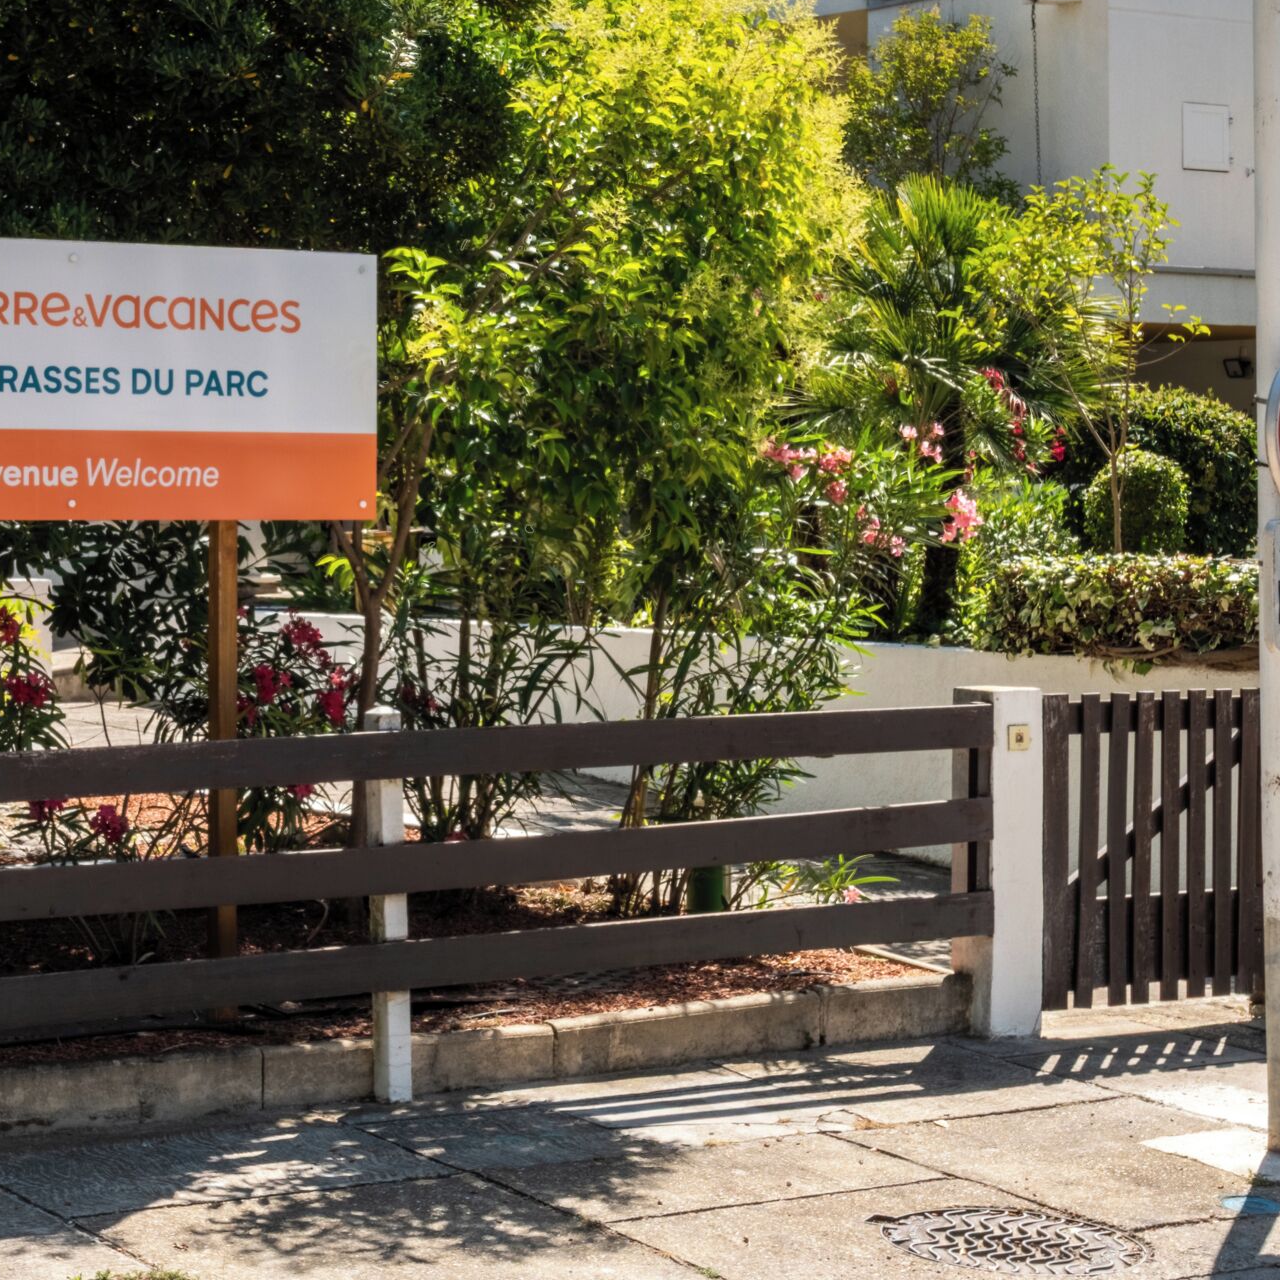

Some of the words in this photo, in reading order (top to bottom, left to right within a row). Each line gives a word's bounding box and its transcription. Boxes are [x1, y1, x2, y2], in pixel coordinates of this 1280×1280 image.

[131, 367, 174, 396] DU
[185, 369, 269, 398] PARC
[86, 458, 219, 487] Welcome
